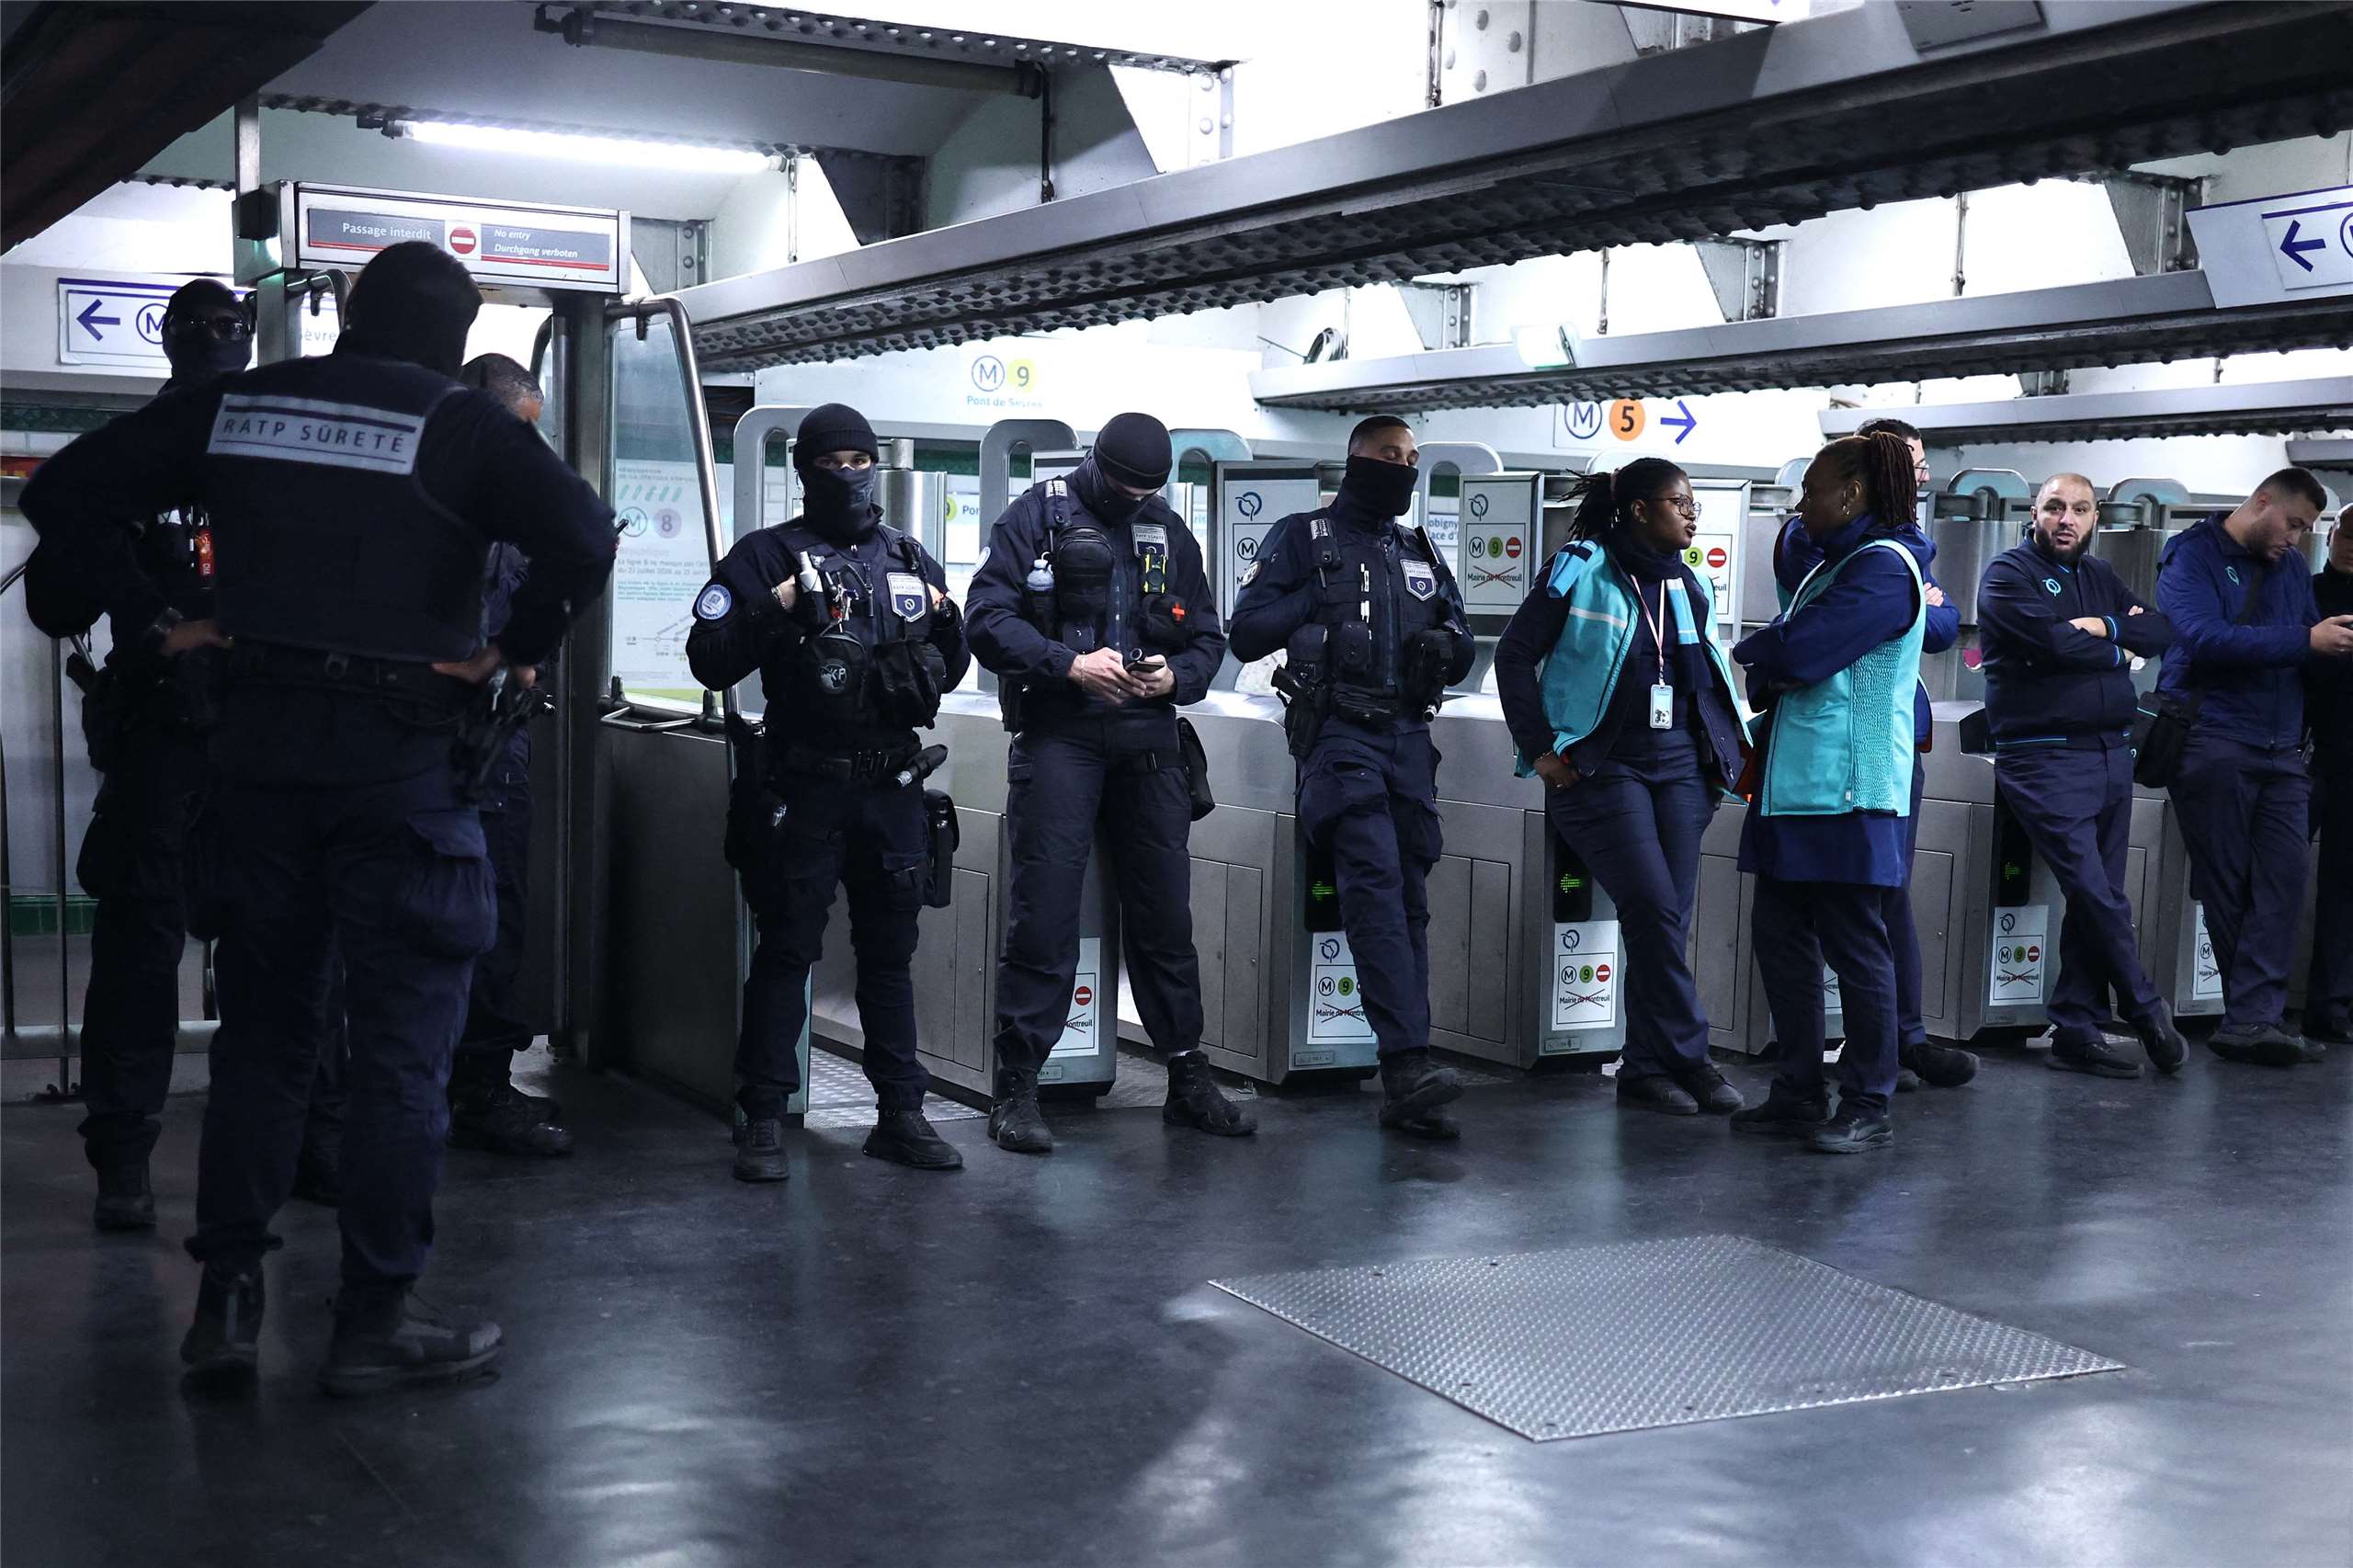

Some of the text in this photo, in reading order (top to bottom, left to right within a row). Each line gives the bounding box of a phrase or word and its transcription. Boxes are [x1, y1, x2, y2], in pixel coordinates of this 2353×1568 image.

[343, 222, 432, 240] Passage interdit
[494, 229, 531, 242] No entry
[494, 244, 578, 258] Durchgang verboten
[967, 395, 991, 405] Pont
[993, 397, 1006, 406] de
[1620, 405, 1634, 433] 5
[223, 418, 404, 453] RATP SÛRETÉ
[1429, 517, 1458, 530] obigny
